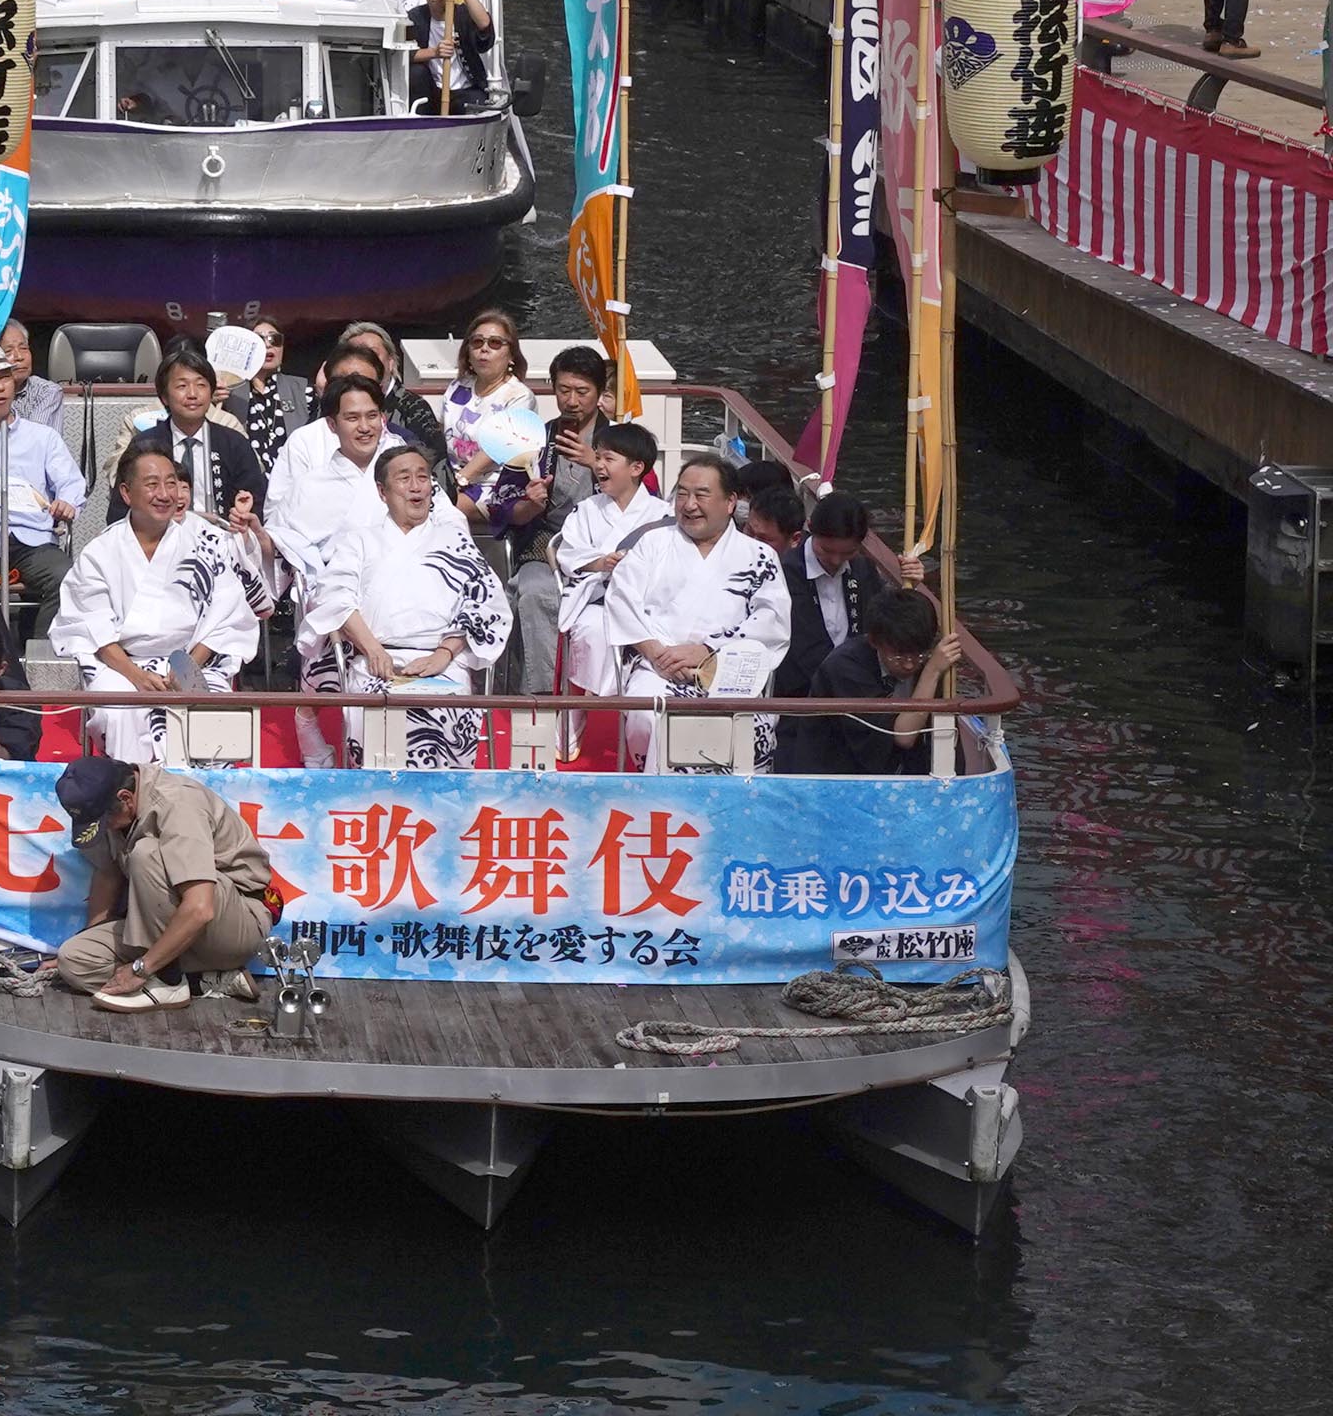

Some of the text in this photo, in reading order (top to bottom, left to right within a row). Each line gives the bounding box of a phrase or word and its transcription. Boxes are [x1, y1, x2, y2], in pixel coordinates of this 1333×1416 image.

[727, 866, 977, 915] 船乗り込み
[895, 930, 976, 959] 松竹座
